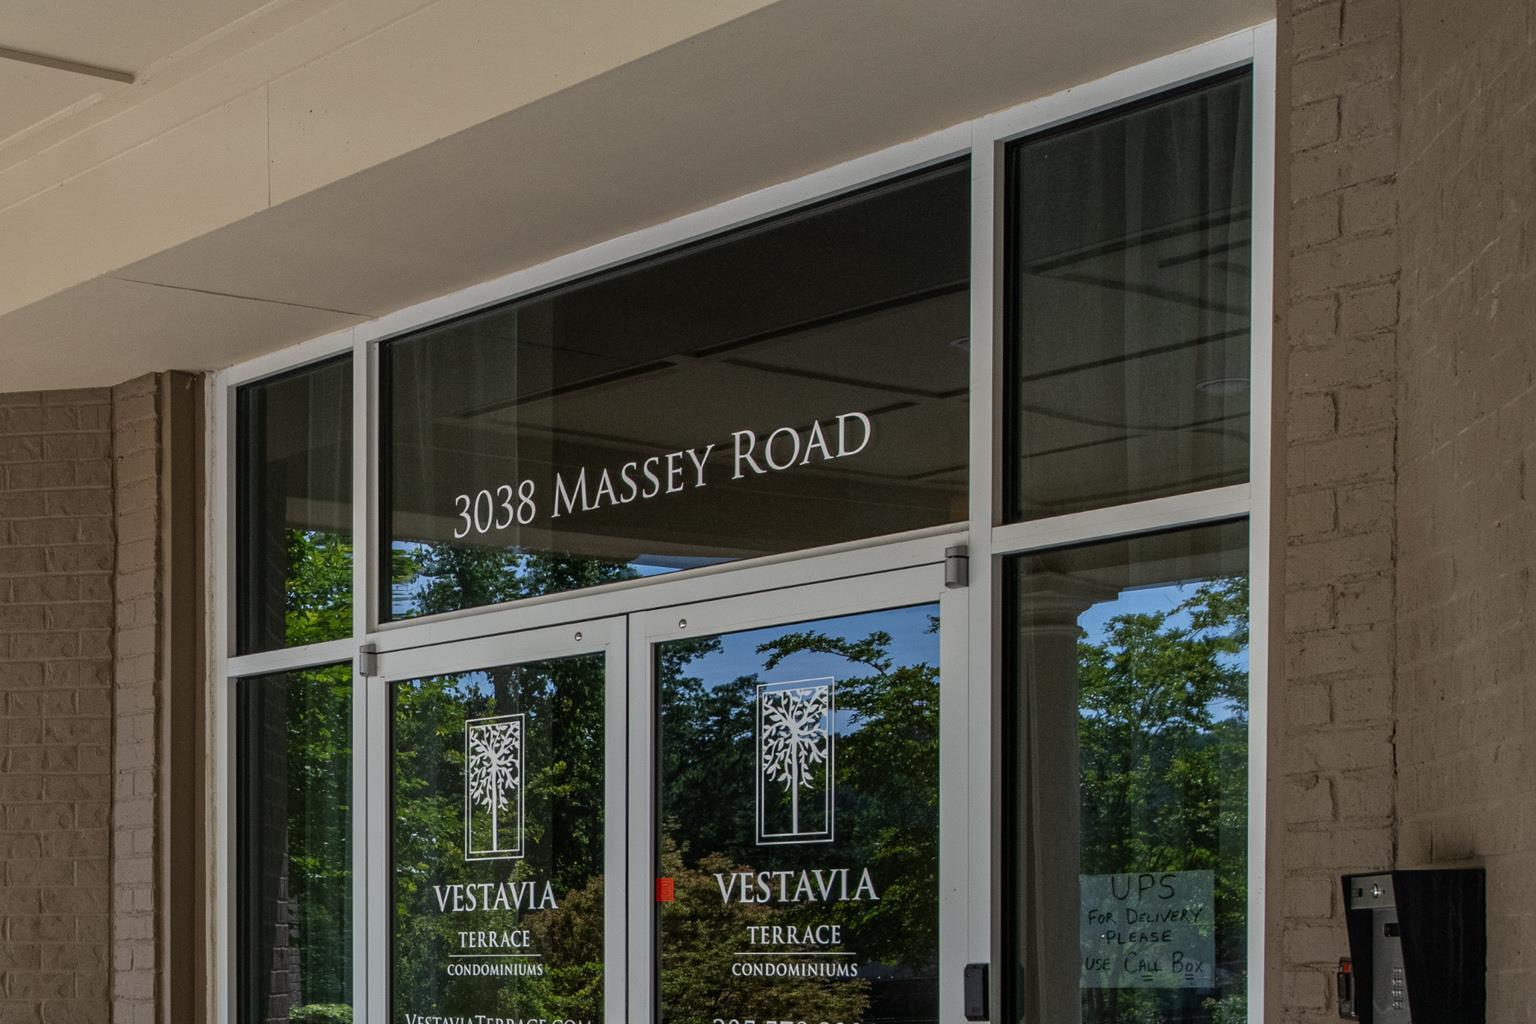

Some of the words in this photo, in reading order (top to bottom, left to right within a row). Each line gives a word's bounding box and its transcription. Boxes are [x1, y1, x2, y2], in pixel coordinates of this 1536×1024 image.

[453, 479, 536, 538] 3038
[714, 867, 880, 904] VESTAVIA
[1111, 873, 1177, 901] UPS
[433, 880, 559, 913] VESTAVIA
[458, 930, 530, 948] TERRACE
[746, 924, 841, 946] TERRACE
[1106, 929, 1172, 945] PLEASE
[447, 962, 544, 977] CONDOMINIUMS
[731, 961, 859, 977] CONDOMINIUMS
[1085, 957, 1112, 971] USE
